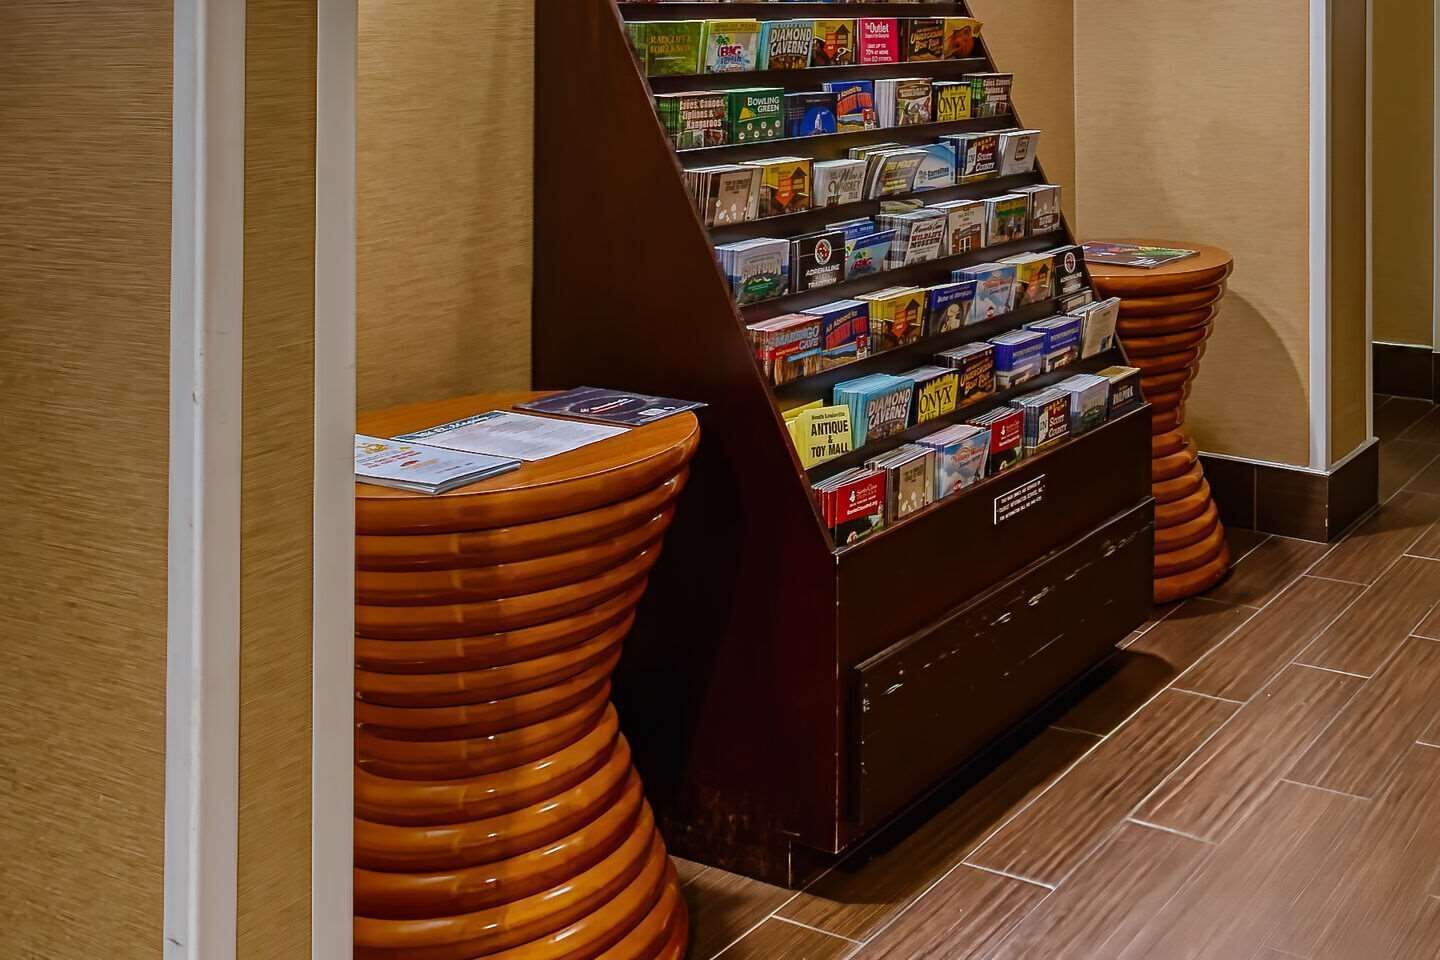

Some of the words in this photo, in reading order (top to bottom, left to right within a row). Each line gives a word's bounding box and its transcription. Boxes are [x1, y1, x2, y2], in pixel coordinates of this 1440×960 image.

[869, 21, 889, 33] Outlet
[770, 28, 811, 43] DIAMOND
[720, 45, 742, 57] BIG
[770, 40, 809, 56] CAVERNS
[747, 96, 779, 106] BOWLING
[938, 95, 967, 119] ONYX
[757, 104, 779, 112] GREEN
[686, 119, 722, 130] Kangaroos
[911, 230, 942, 242] WILDLIFE
[909, 238, 940, 249] MUSEUM
[805, 264, 840, 277] ADRENALINE
[808, 278, 837, 289] TRADITION
[799, 338, 819, 350] CAVE
[868, 388, 911, 416] DIAMOND
[920, 385, 953, 416] ONYX
[868, 404, 907, 430] CAVERNS
[811, 420, 849, 436] ANTIQUE
[828, 435, 833, 444] &
[811, 445, 827, 458] TOY
[828, 442, 849, 456] MALL
